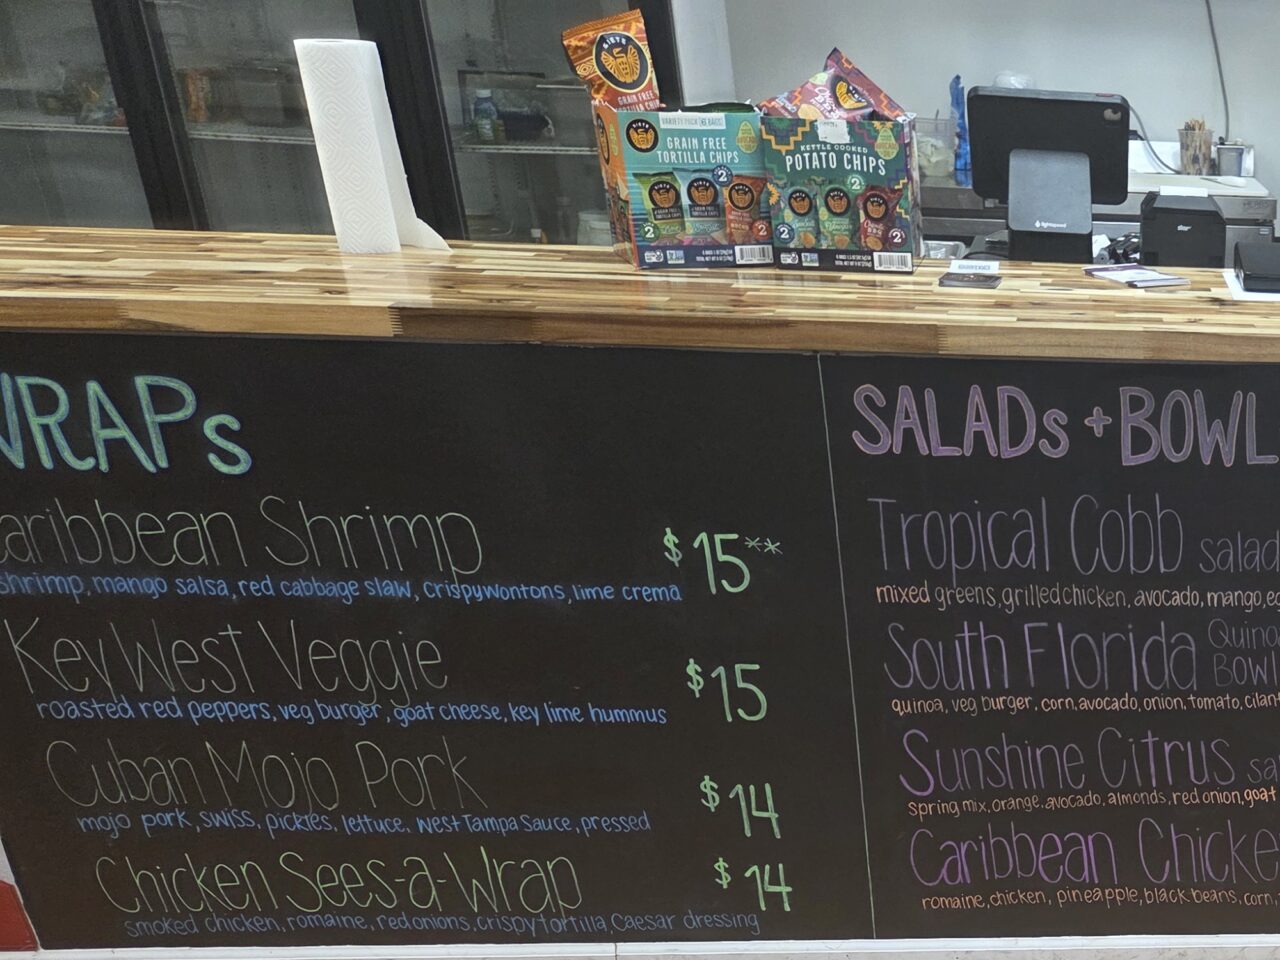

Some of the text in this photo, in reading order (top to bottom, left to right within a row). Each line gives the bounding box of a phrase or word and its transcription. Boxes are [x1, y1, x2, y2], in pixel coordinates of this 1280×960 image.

[638, 90, 655, 103] FREE
[656, 151, 739, 163] TORTILLA CHIPS
[666, 137, 727, 149] GRAIN FREE
[800, 144, 868, 153] KETTLE COOKED
[785, 152, 886, 175] POTATO CHIPS
[0, 497, 248, 567] aribbean
[260, 495, 482, 586] Shrimp
[867, 497, 1050, 587] Tropical
[1070, 492, 1183, 576] Cobb
[1199, 529, 1280, 575] salad
[93, 573, 168, 599] mango
[238, 574, 275, 598] red
[280, 574, 361, 605] cabbage
[573, 582, 614, 601] lime
[622, 583, 683, 602] crema
[875, 579, 931, 605] mixed
[1002, 582, 1061, 613] grilled
[257, 619, 447, 708] Veggie
[883, 620, 1009, 691] South
[1023, 620, 1198, 692] Florida
[36, 694, 135, 720] roasted
[139, 695, 183, 719] red
[278, 702, 315, 725] veg
[392, 703, 434, 727] goat
[509, 702, 541, 727] key
[545, 702, 584, 724] lime
[589, 702, 667, 724] hummus
[952, 700, 979, 717] veg
[47, 738, 206, 807] Cuban
[205, 740, 339, 814] Mojo
[356, 736, 488, 810] Pork
[899, 728, 1086, 797] Sunshine
[1098, 726, 1236, 789] Citrus
[908, 799, 960, 822] spring
[1172, 788, 1200, 806] red
[1244, 785, 1277, 808] goat
[77, 813, 131, 838] mojo
[581, 810, 651, 837] pressed
[910, 821, 1118, 887] Caribbean
[96, 853, 278, 912] Chicken
[1144, 886, 1191, 905] black
[124, 912, 199, 937] smoked
[684, 909, 761, 935] dressing
